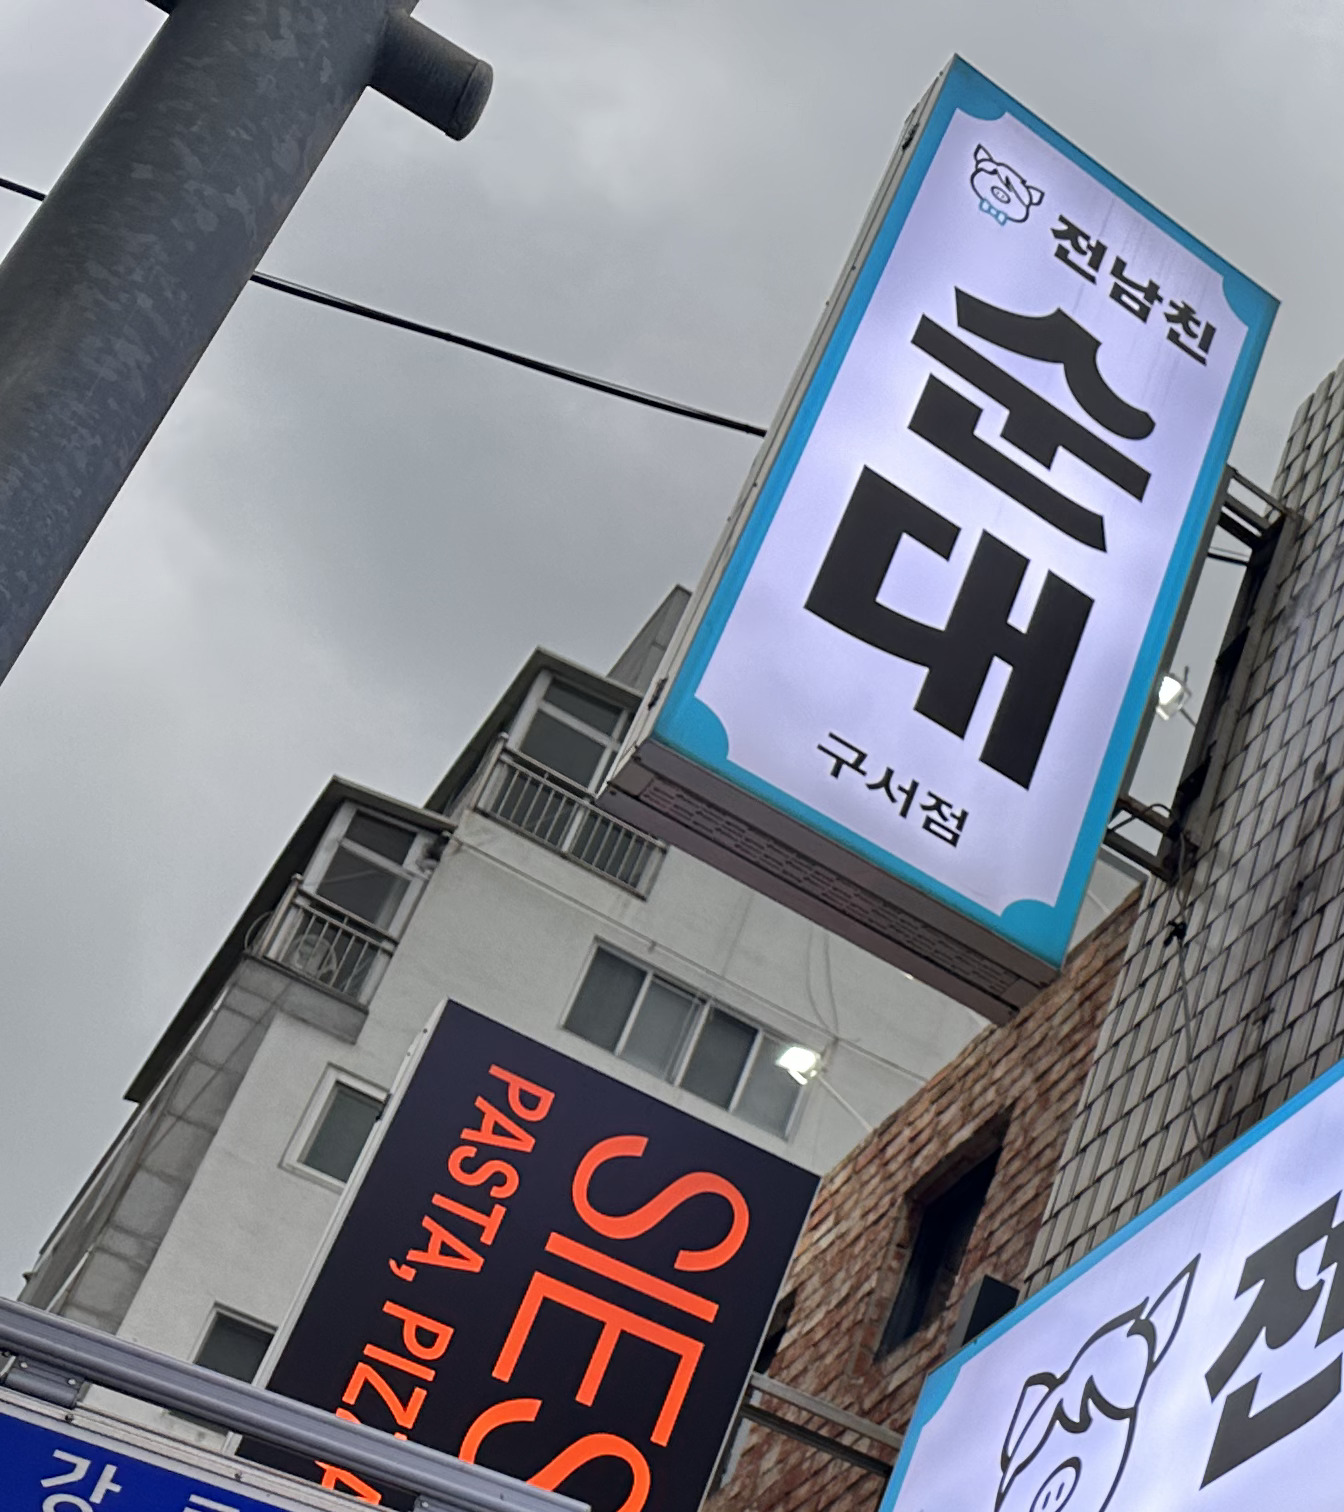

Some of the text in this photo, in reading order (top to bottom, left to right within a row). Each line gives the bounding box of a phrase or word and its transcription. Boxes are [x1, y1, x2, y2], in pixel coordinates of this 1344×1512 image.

[1051, 215, 1217, 366] 전남친
[805, 286, 1155, 791] 순대
[816, 732, 967, 848] 구서점
[314, 1064, 555, 1506] PASTA, PIZA
